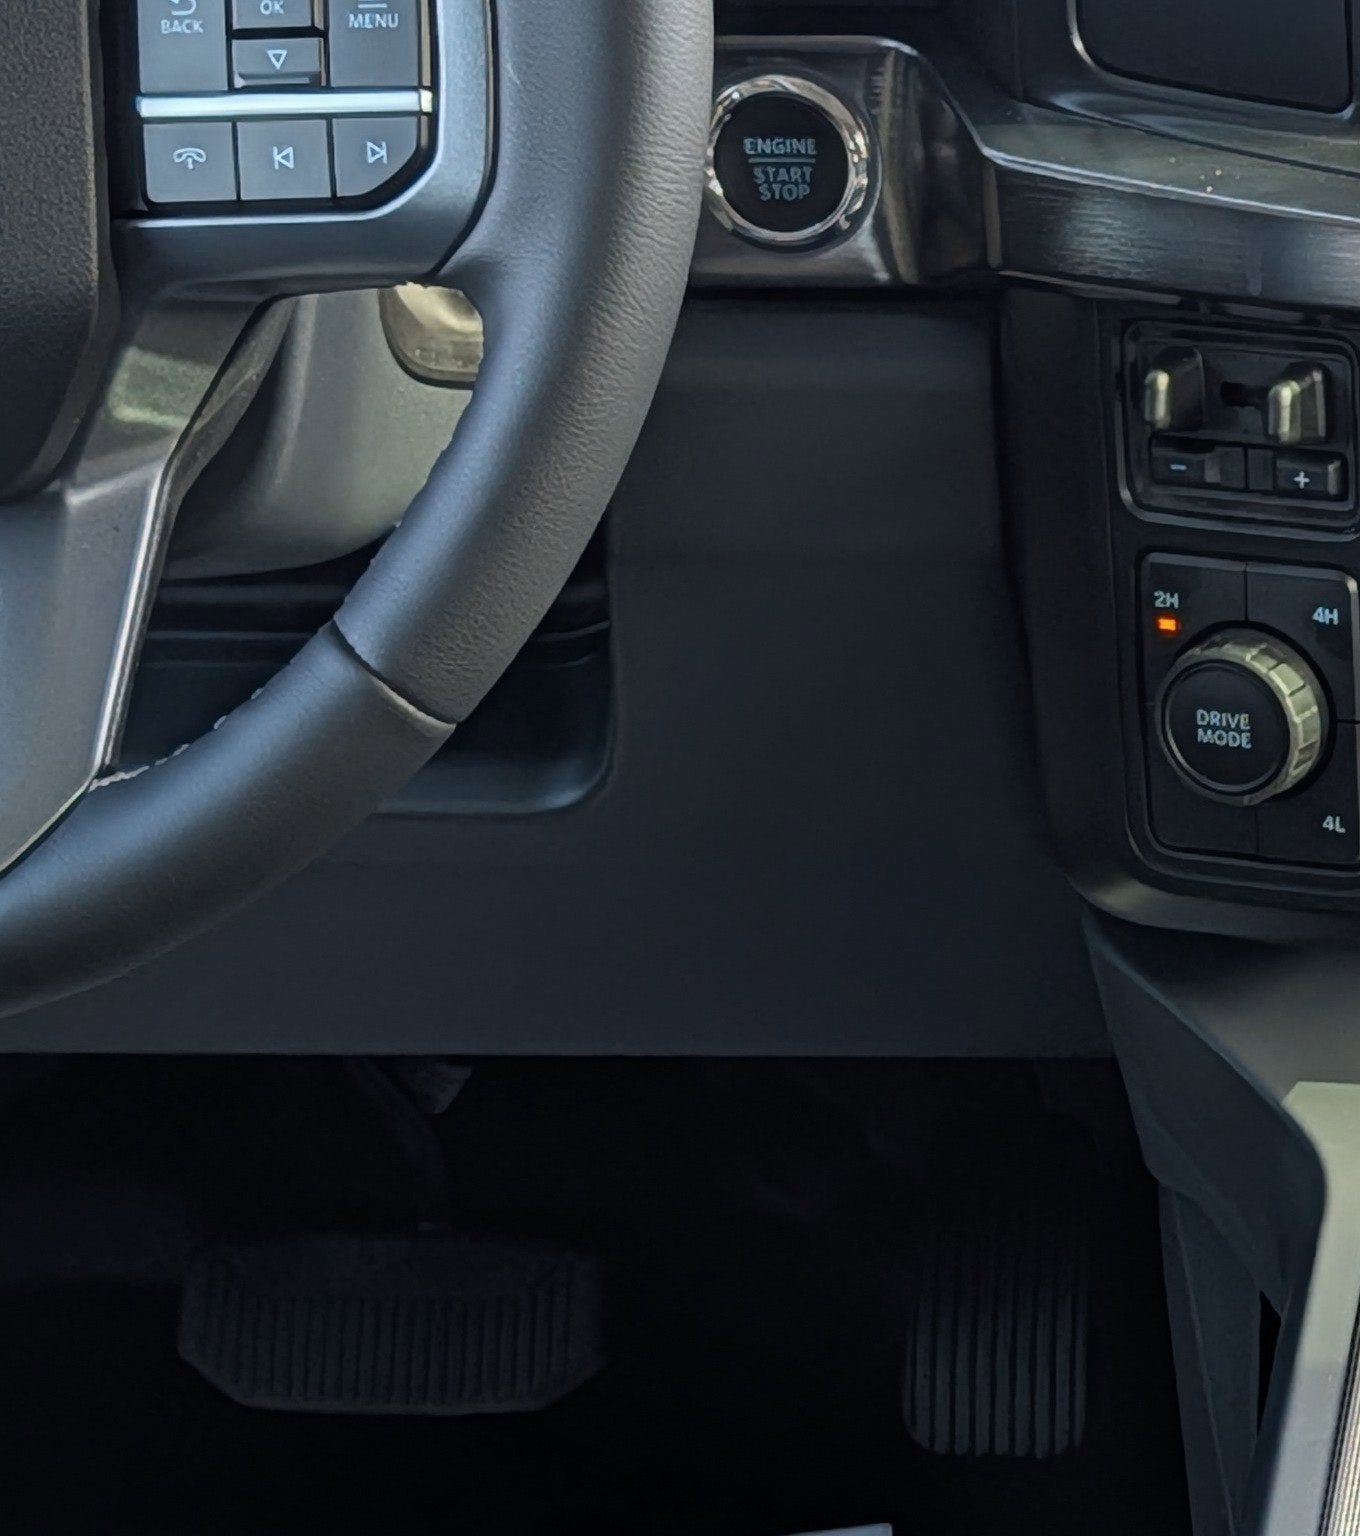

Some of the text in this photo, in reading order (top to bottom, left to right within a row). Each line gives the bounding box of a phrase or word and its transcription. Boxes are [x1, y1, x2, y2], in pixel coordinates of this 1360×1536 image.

[259, 0, 284, 15] OK
[160, 19, 204, 34] BACK
[349, 12, 399, 29] MENU
[743, 138, 818, 154] ENGINE
[753, 166, 813, 183] START
[759, 183, 810, 201] STOP
[1154, 591, 1179, 608] 2H
[1312, 607, 1338, 625] 4H
[1196, 709, 1251, 730] DRIVE
[1197, 727, 1252, 748] MODE
[1322, 815, 1346, 833] 4L
